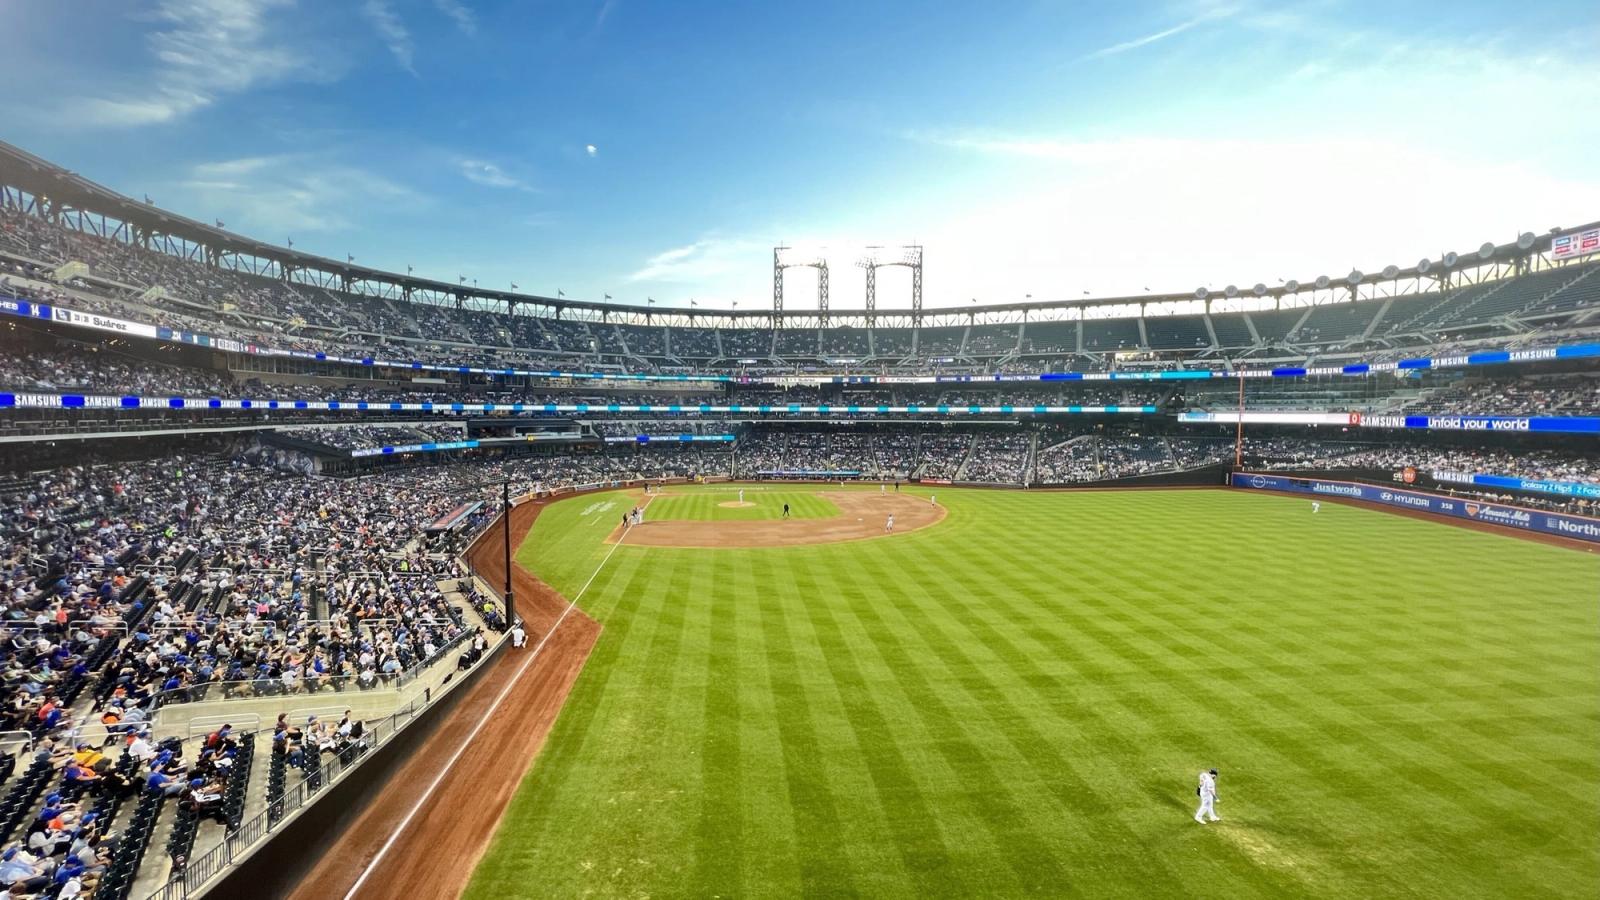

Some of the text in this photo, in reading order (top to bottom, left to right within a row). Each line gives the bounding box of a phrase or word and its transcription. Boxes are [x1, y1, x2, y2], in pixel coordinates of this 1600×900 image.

[30, 303, 40, 317] 14
[93, 317, 127, 331] Suárez
[1430, 355, 1469, 367] SAMSUNG
[1509, 348, 1557, 361] SAMSUNG
[1306, 367, 1343, 375] SAMSUNG
[1368, 362, 1399, 371] SAMSUNG
[14, 394, 62, 407] SAMSUNG
[84, 396, 122, 406] SAMSUNG
[139, 397, 170, 408] SAMSUNG
[1360, 415, 1405, 427] SAMSUNG
[1428, 415, 1529, 430] Unfold your world
[1433, 471, 1475, 484] SAMSUNG
[1313, 483, 1362, 496] Justworks
[1521, 481, 1547, 491] Galaxy
[1394, 495, 1430, 508] HYUNDAI
[1559, 520, 1600, 536] North
